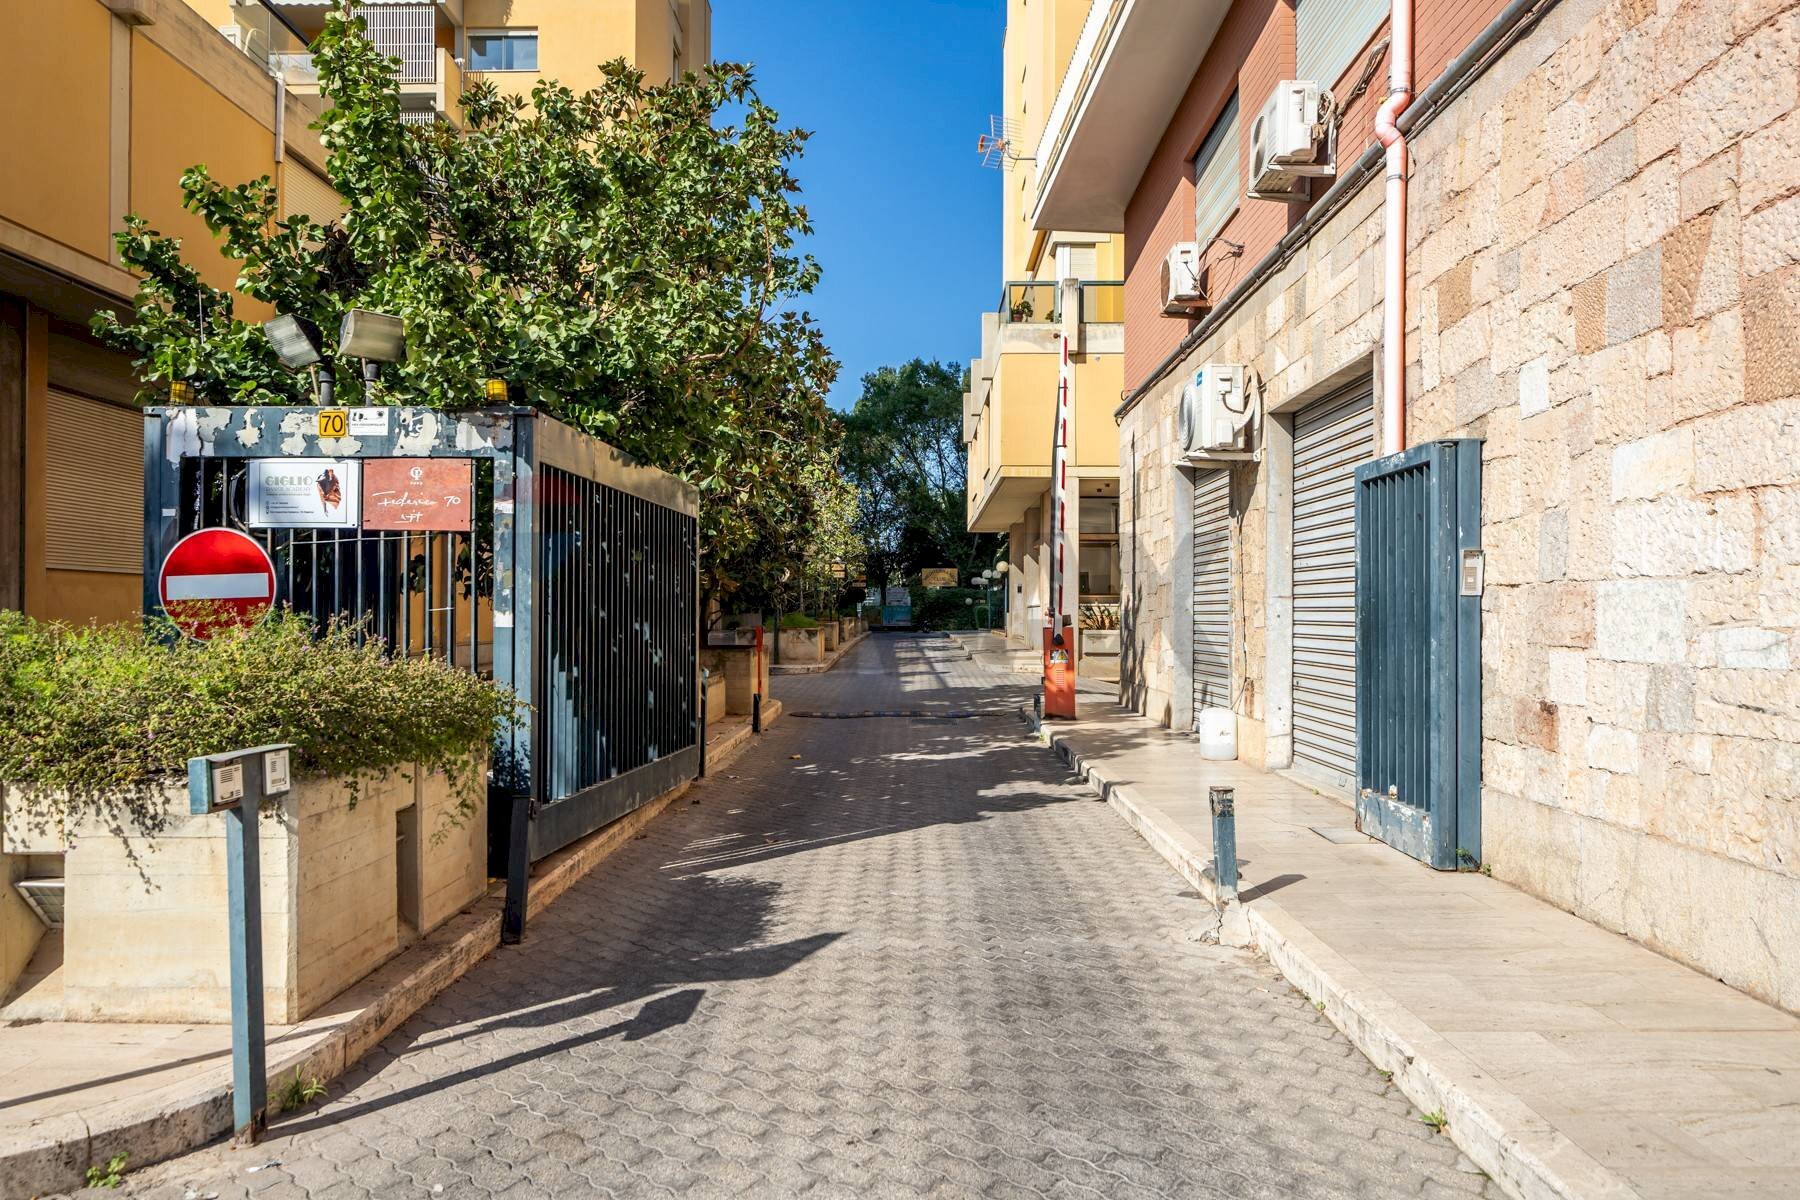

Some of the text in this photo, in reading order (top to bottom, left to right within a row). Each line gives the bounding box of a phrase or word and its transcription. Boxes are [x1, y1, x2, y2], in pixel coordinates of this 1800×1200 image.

[321, 415, 343, 433] 70
[371, 490, 461, 508] Federico 70
